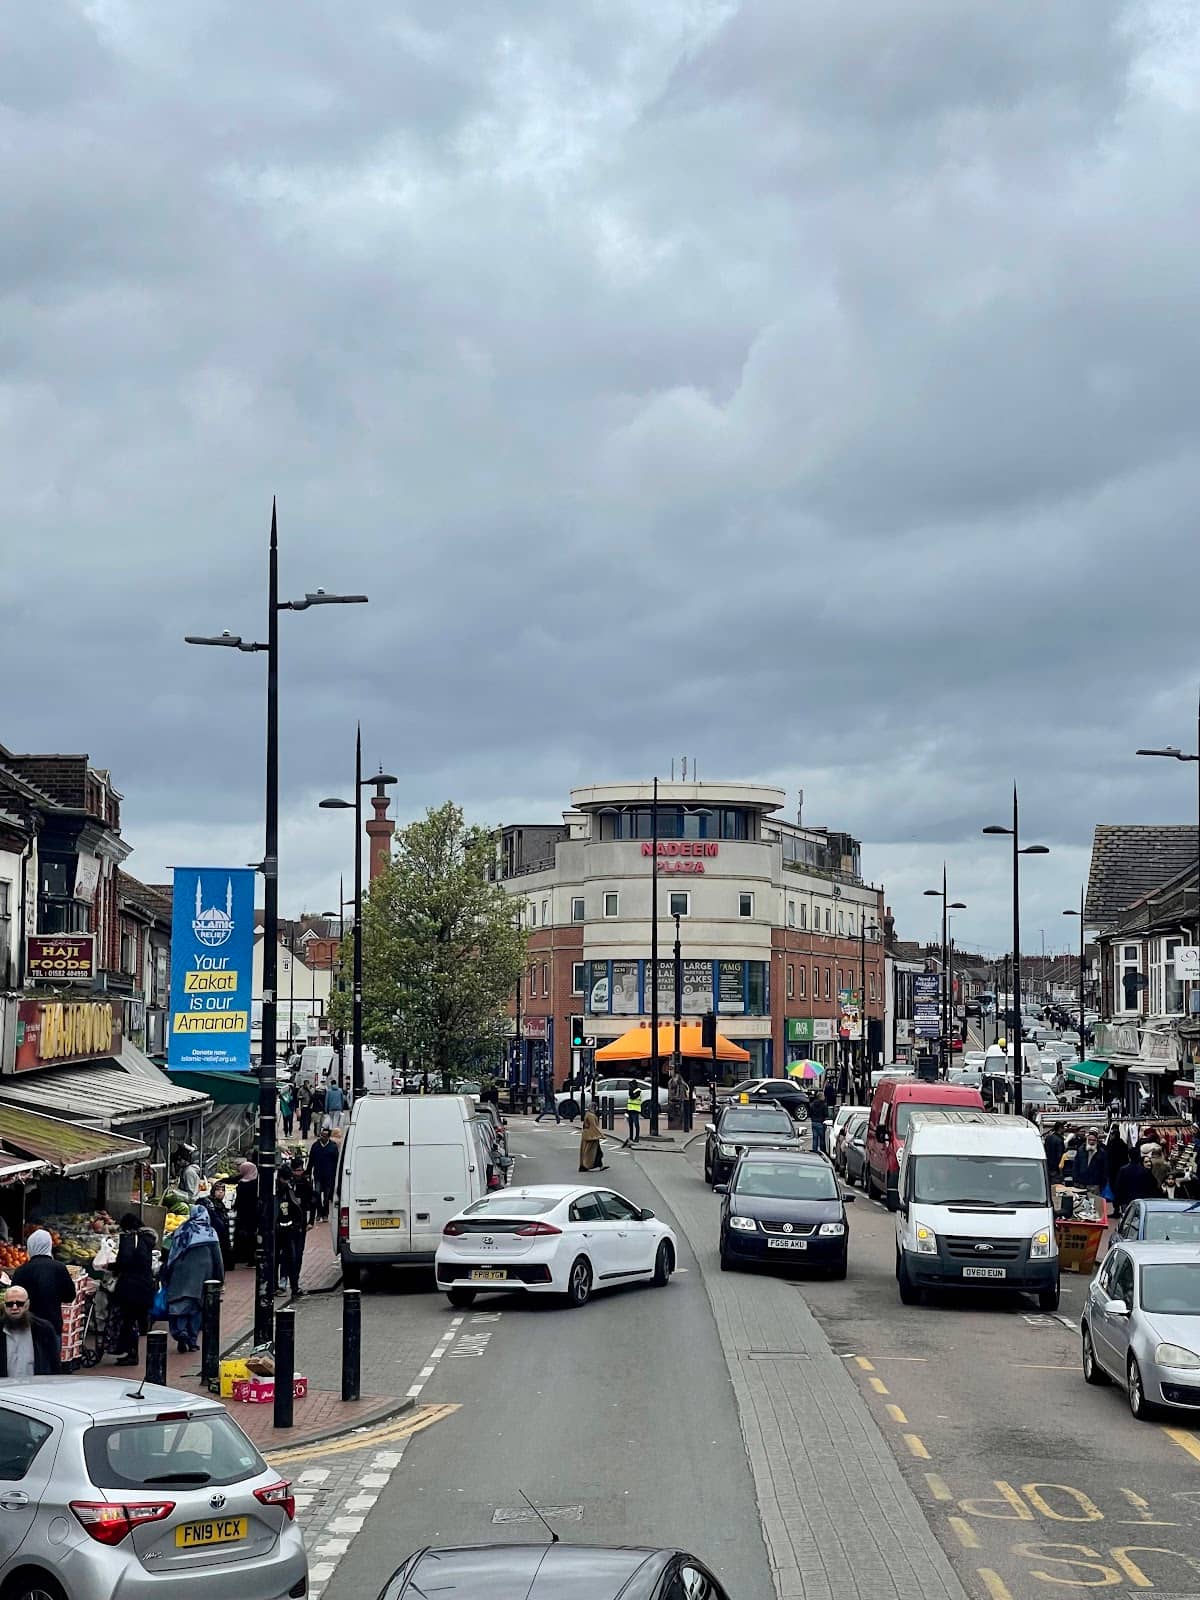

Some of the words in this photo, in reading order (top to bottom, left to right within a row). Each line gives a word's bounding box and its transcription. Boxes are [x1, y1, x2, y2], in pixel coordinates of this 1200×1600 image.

[641, 842, 718, 857] NADEEM
[656, 861, 704, 873] PLAZA
[192, 920, 235, 929] ISLAMIC
[42, 947, 79, 959] HAJI
[30, 960, 91, 969] FOODS
[193, 953, 230, 970] Your
[683, 962, 712, 970] LARGE
[645, 969, 675, 977] HLAL
[683, 975, 712, 983] CAKES
[188, 973, 234, 990] Zakat
[190, 993, 203, 1010] is
[206, 997, 234, 1010] our
[177, 1013, 244, 1031] Amanah
[987, 1269, 1003, 1277] EUN
[184, 1524, 213, 1542] FN19
[217, 1521, 240, 1538] YCX
